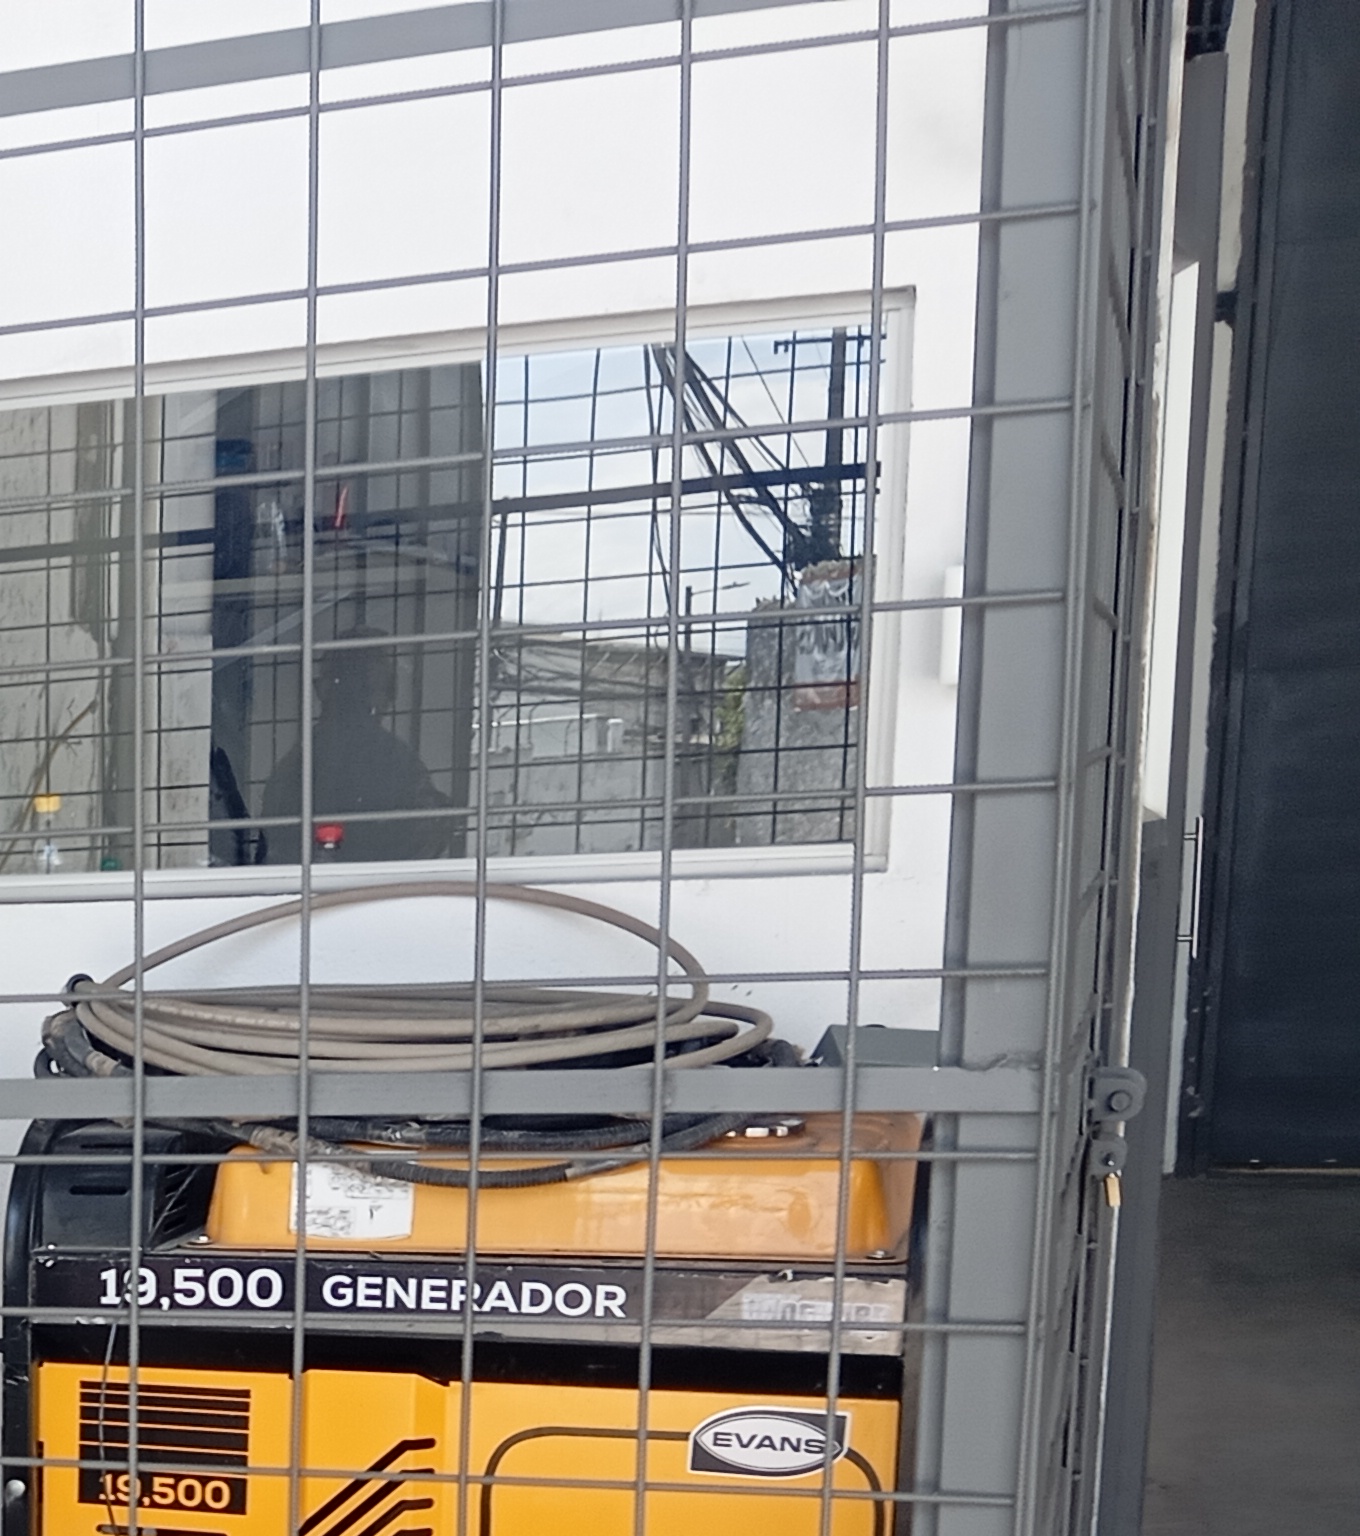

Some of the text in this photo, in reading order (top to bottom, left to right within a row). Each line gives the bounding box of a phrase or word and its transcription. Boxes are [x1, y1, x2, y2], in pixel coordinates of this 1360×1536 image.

[99, 1267, 627, 1319] 19,500 GENERADOR
[712, 1431, 828, 1455] EVANS
[98, 1473, 231, 1510] 19,500
